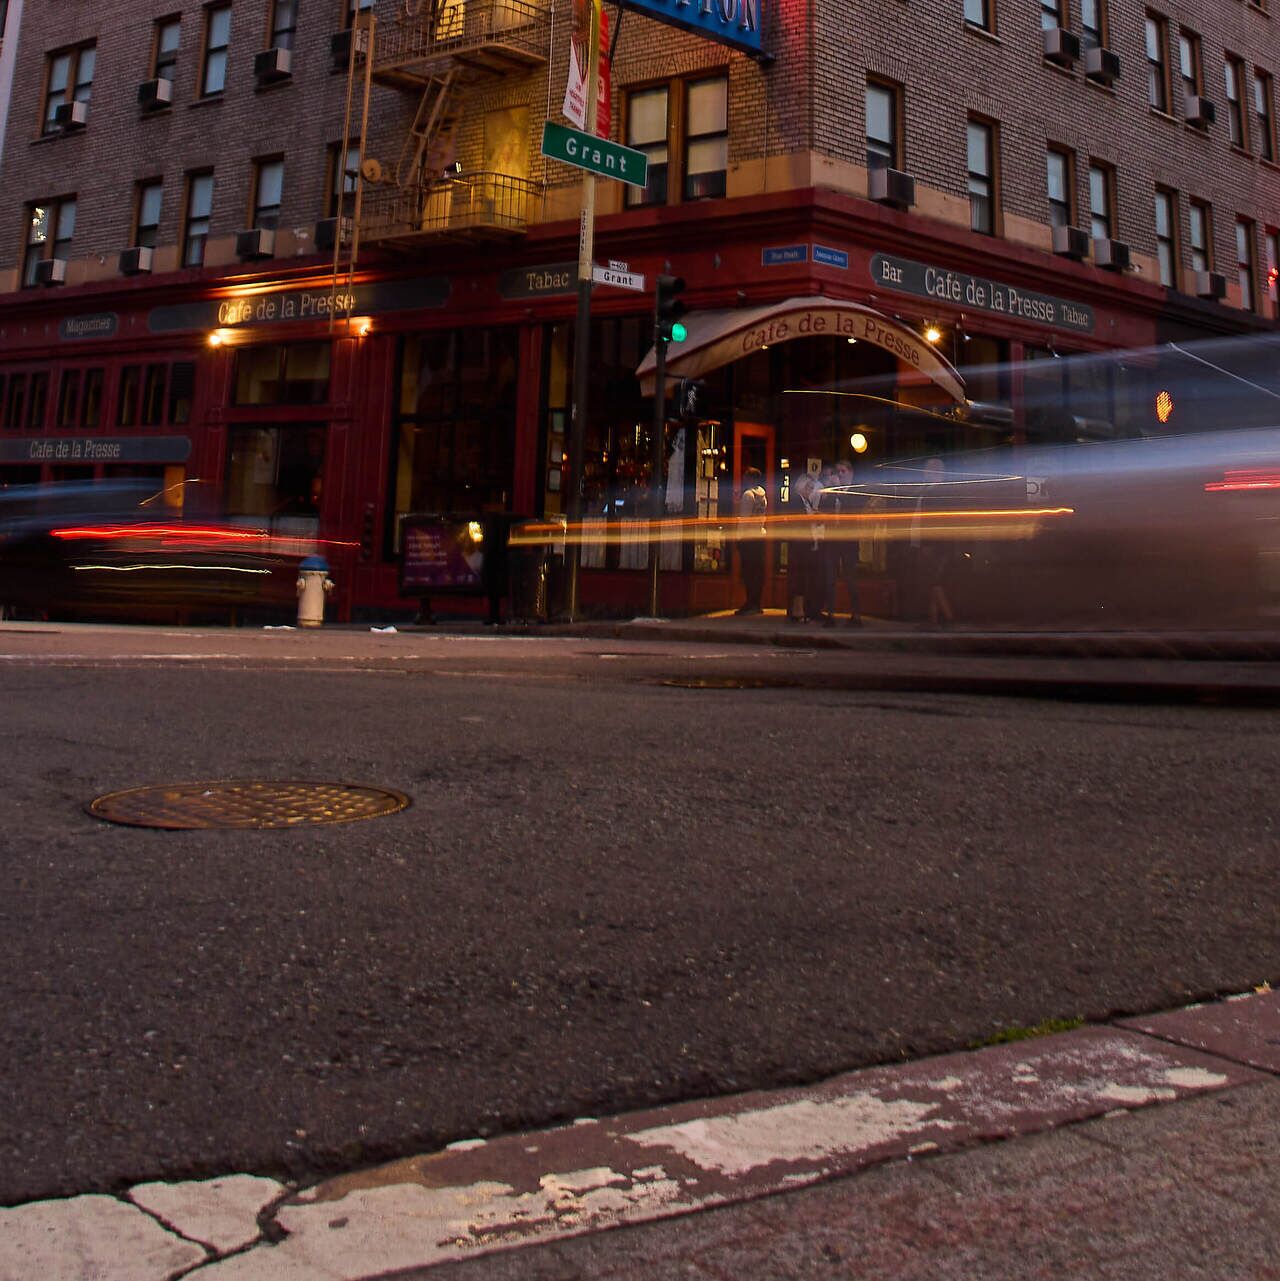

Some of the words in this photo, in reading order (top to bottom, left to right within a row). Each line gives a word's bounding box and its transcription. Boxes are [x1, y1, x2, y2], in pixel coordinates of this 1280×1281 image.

[565, 137, 627, 173] Grant
[526, 271, 569, 291] Tabac
[603, 271, 634, 286] Grant
[256, 298, 276, 320] de
[281, 296, 295, 318] la
[300, 292, 356, 316] Presse
[881, 261, 903, 283] Bar
[966, 278, 986, 306] de
[990, 283, 1004, 311] la
[1008, 288, 1055, 321] Presse
[1060, 305, 1089, 327] Tabac
[798, 313, 826, 334] de
[836, 312, 854, 334] la
[864, 318, 920, 366] Presse
[55, 440, 69, 457] de
[84, 439, 120, 458] Presse
